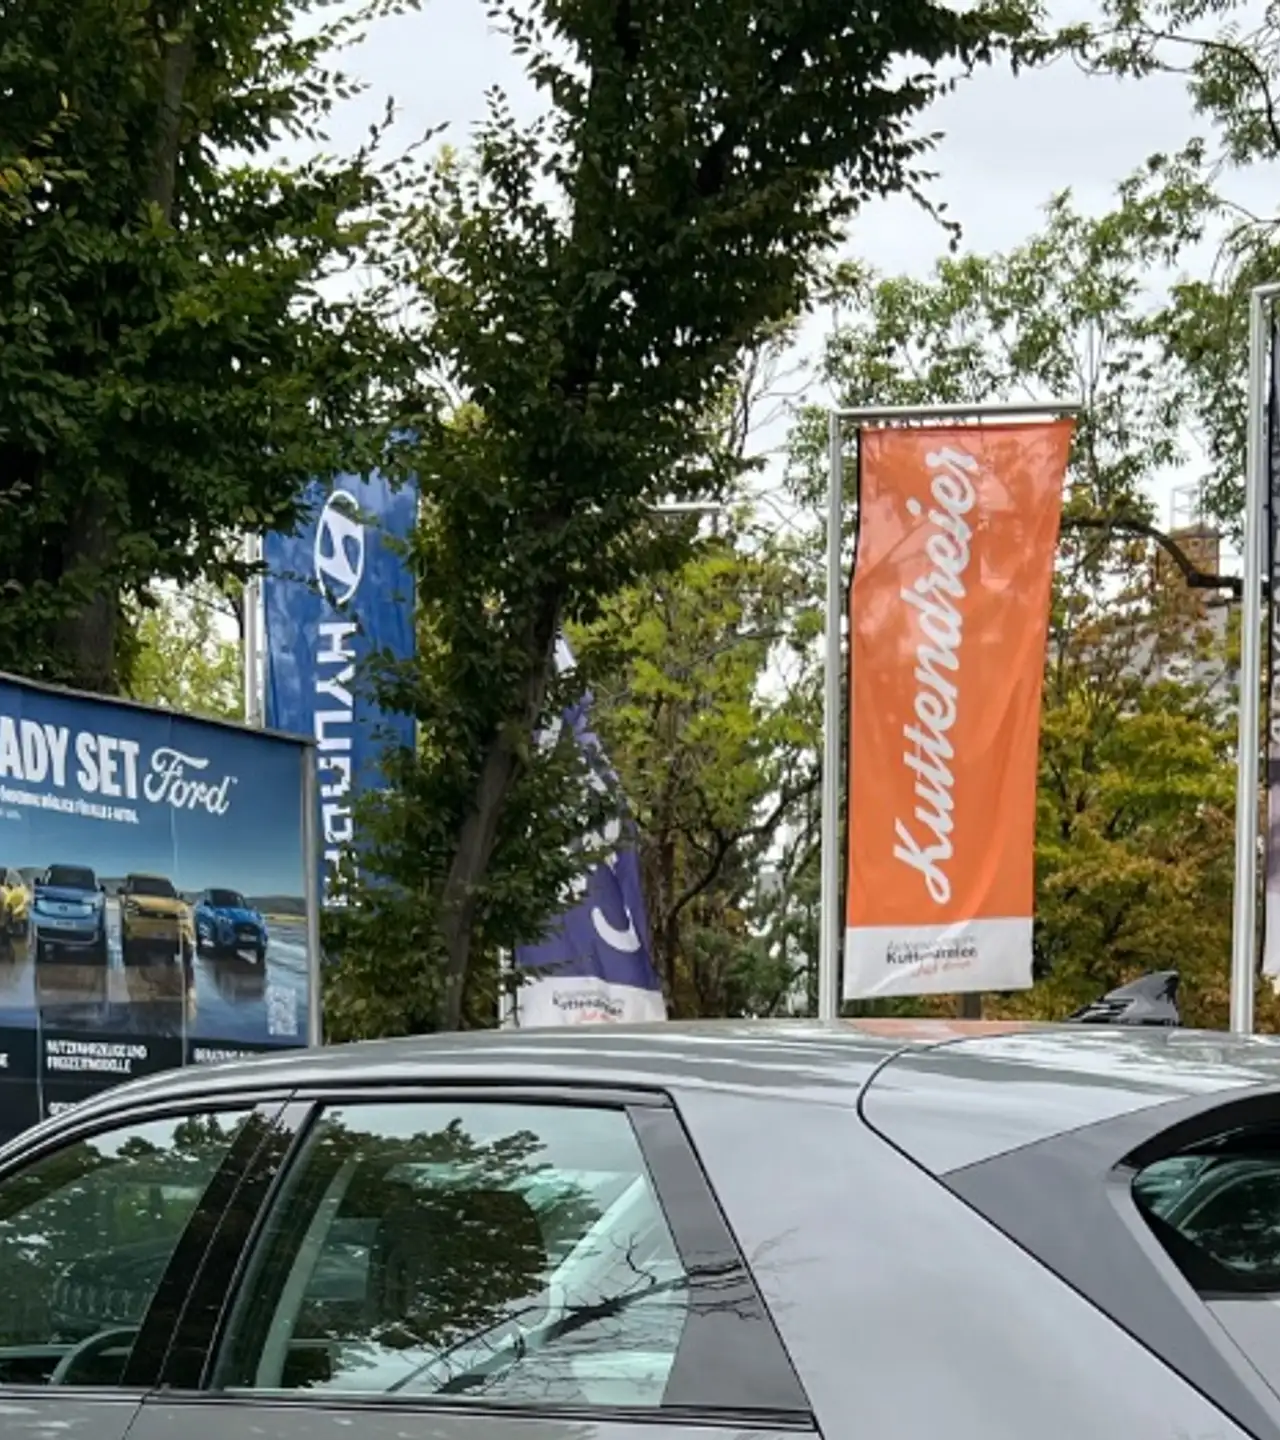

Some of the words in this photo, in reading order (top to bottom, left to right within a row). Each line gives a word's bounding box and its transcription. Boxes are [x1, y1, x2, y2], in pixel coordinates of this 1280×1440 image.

[75, 731, 140, 799] SET
[144, 746, 231, 815] Ford
[892, 446, 978, 905] Kuttendreier
